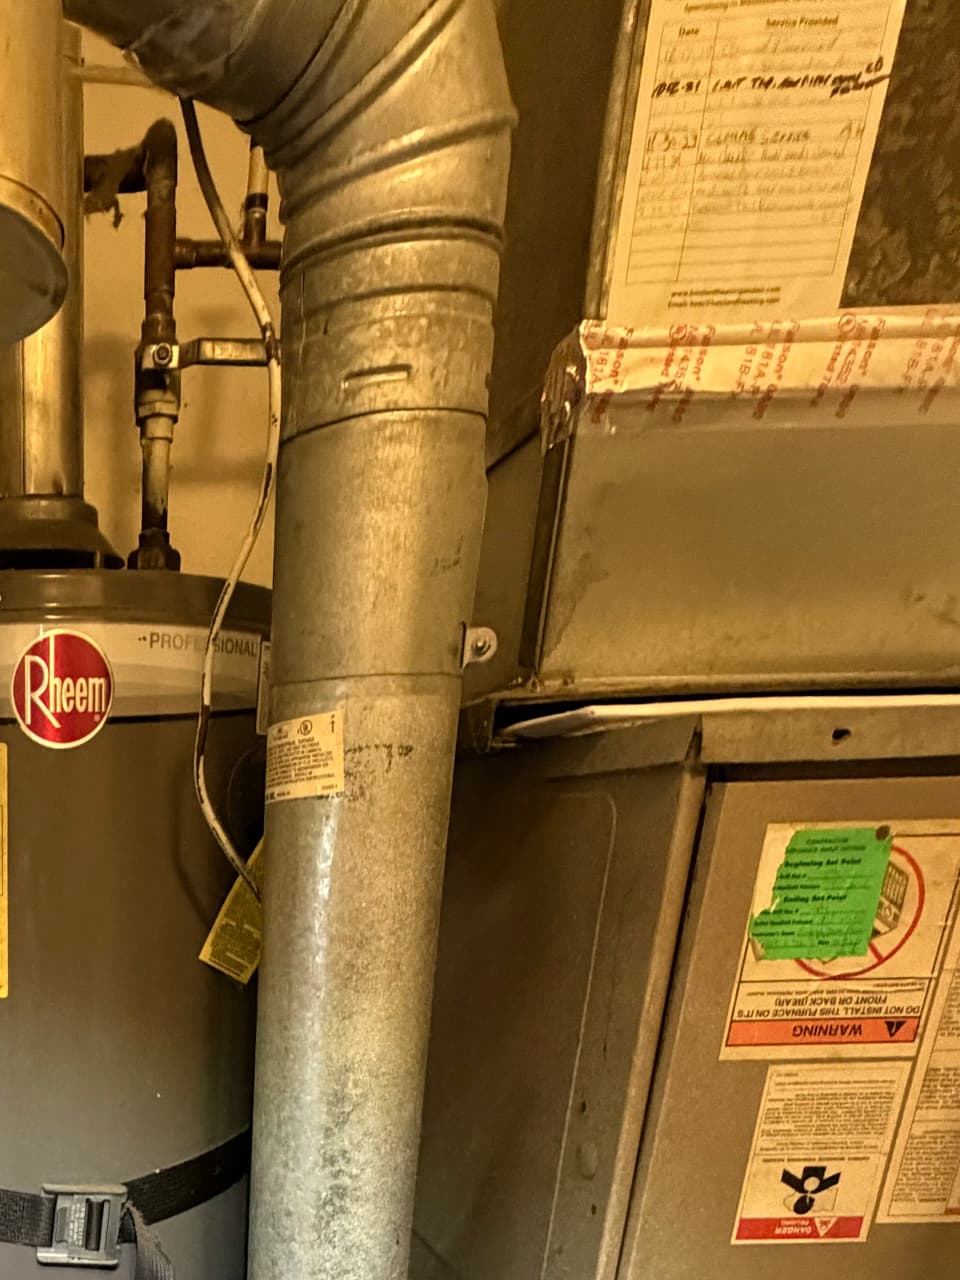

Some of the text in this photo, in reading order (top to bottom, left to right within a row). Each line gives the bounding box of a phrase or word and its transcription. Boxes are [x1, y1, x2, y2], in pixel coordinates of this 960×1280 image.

[150, 631, 258, 657] PROFESIONAL
[24, 634, 106, 729] Rheem
[813, 996, 837, 1005] BACK
[854, 995, 888, 1004] FRONT
[755, 1008, 770, 1018] ON
[771, 1007, 819, 1017] FURNACE
[821, 1007, 840, 1016] THIS
[843, 1006, 883, 1016] INSTALL
[884, 1005, 904, 1014] NOT
[906, 1005, 920, 1014] DO
[792, 1023, 863, 1038] WARNING
[775, 1226, 812, 1235] DANGER
